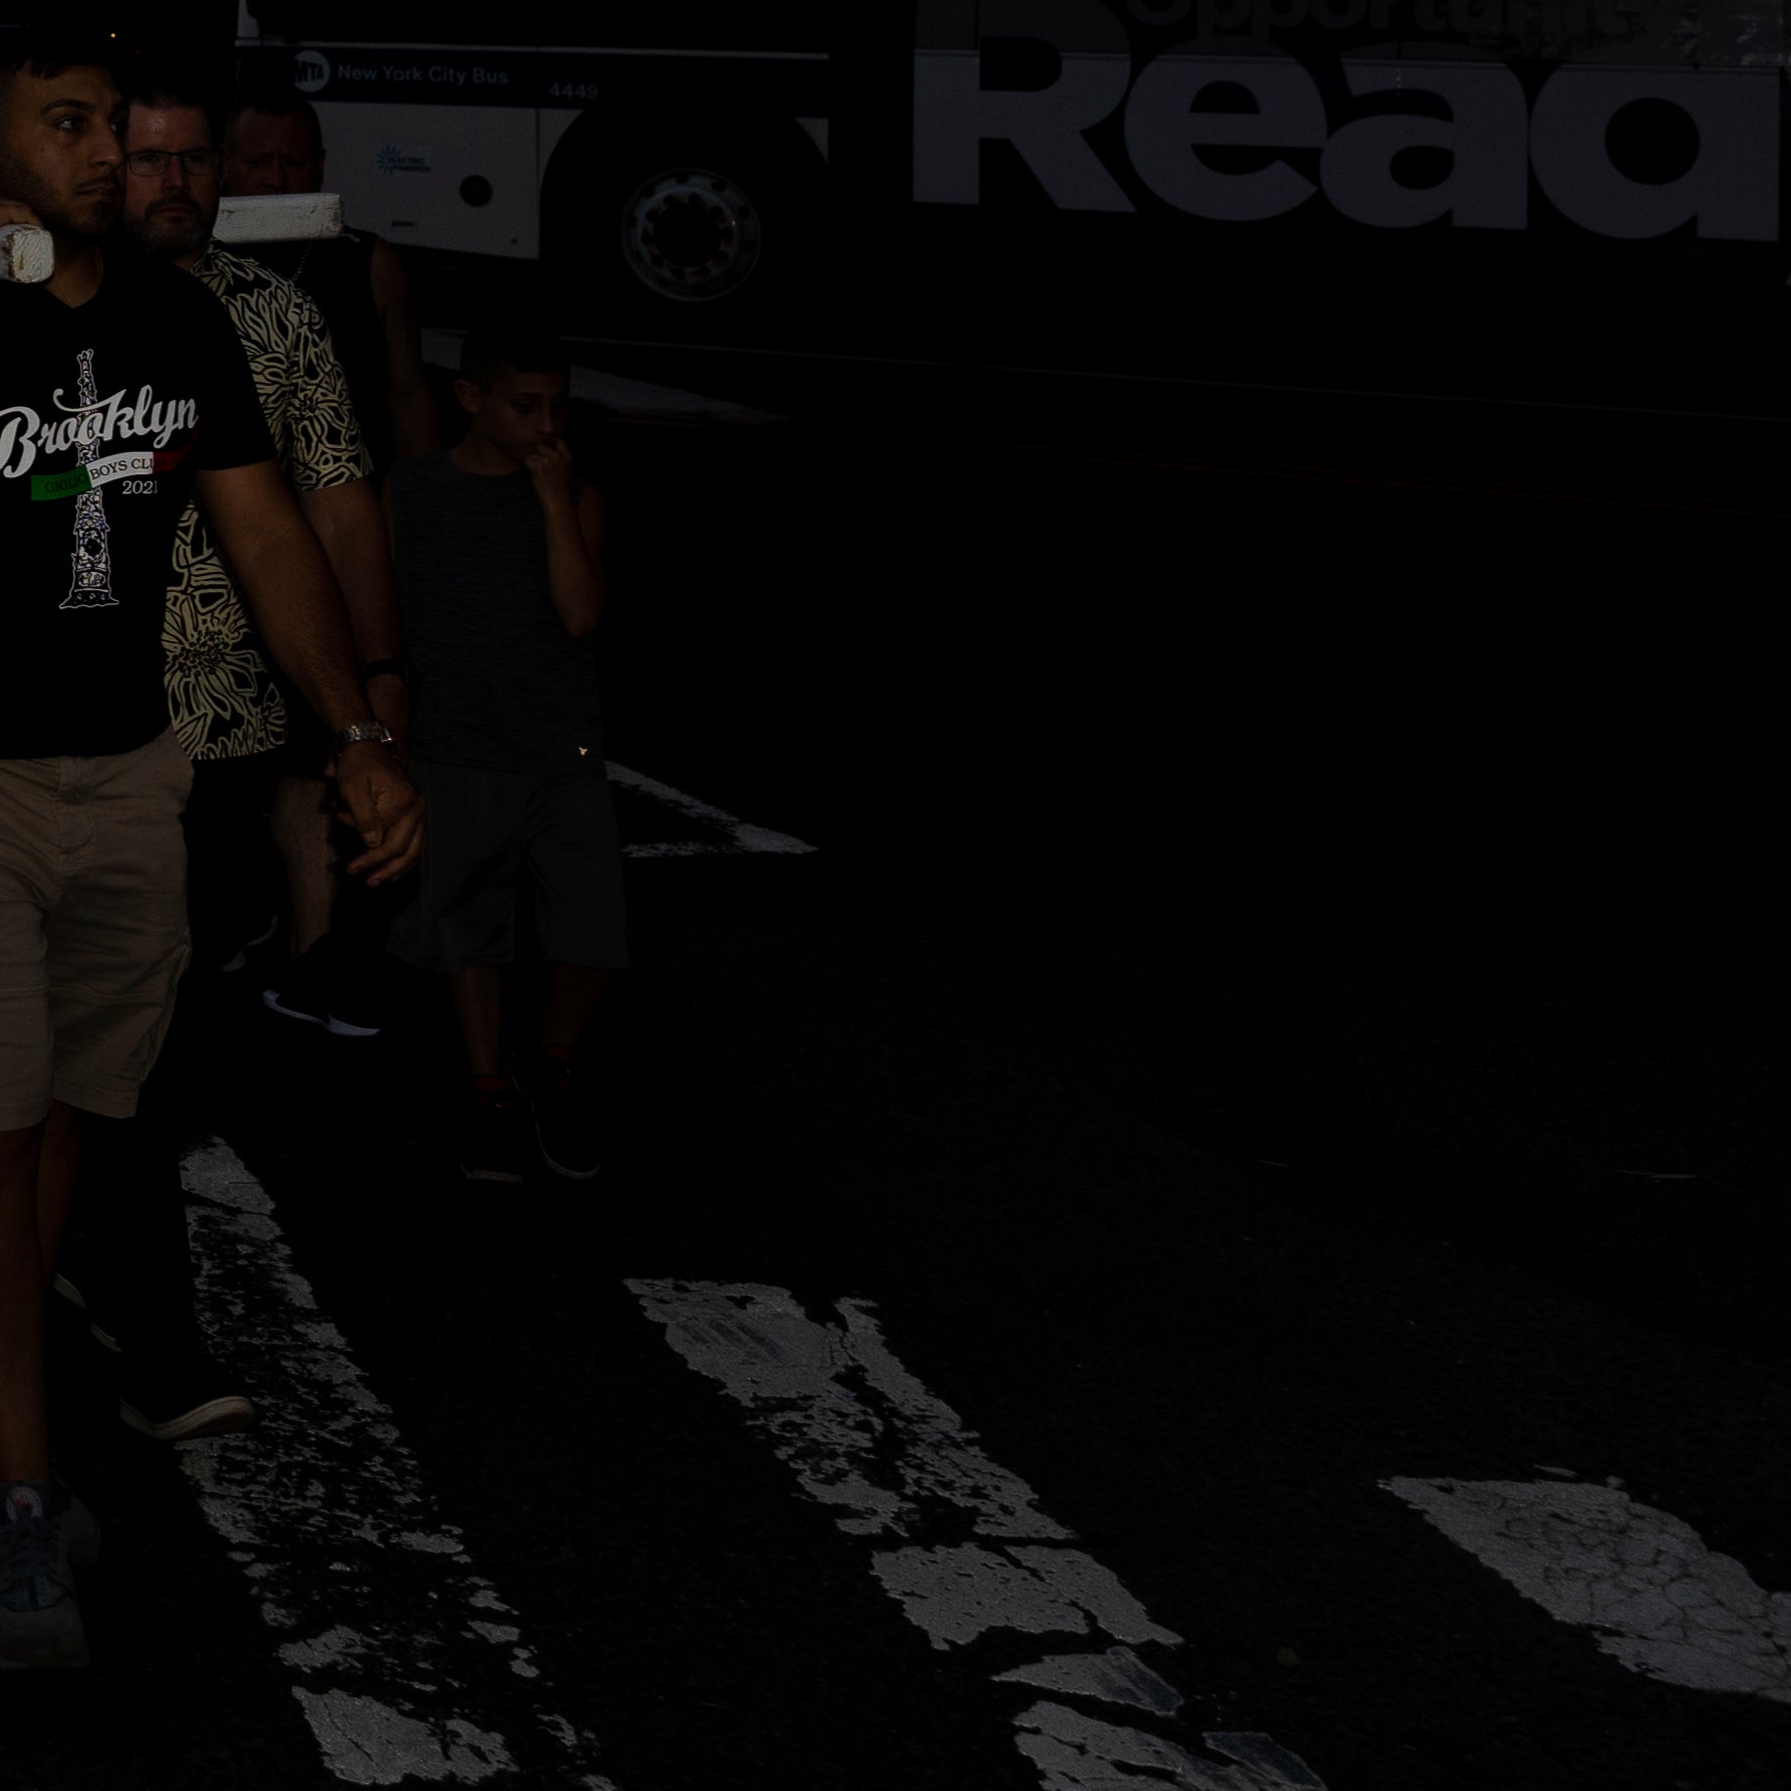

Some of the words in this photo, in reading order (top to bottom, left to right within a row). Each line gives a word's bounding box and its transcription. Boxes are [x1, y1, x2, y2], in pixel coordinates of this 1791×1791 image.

[338, 64, 377, 80] New
[382, 64, 423, 81] York
[428, 65, 466, 86] City
[472, 67, 509, 84] Bus
[548, 82, 599, 99] 4449
[89, 459, 129, 481] BOYS
[121, 479, 159, 496] 2021
